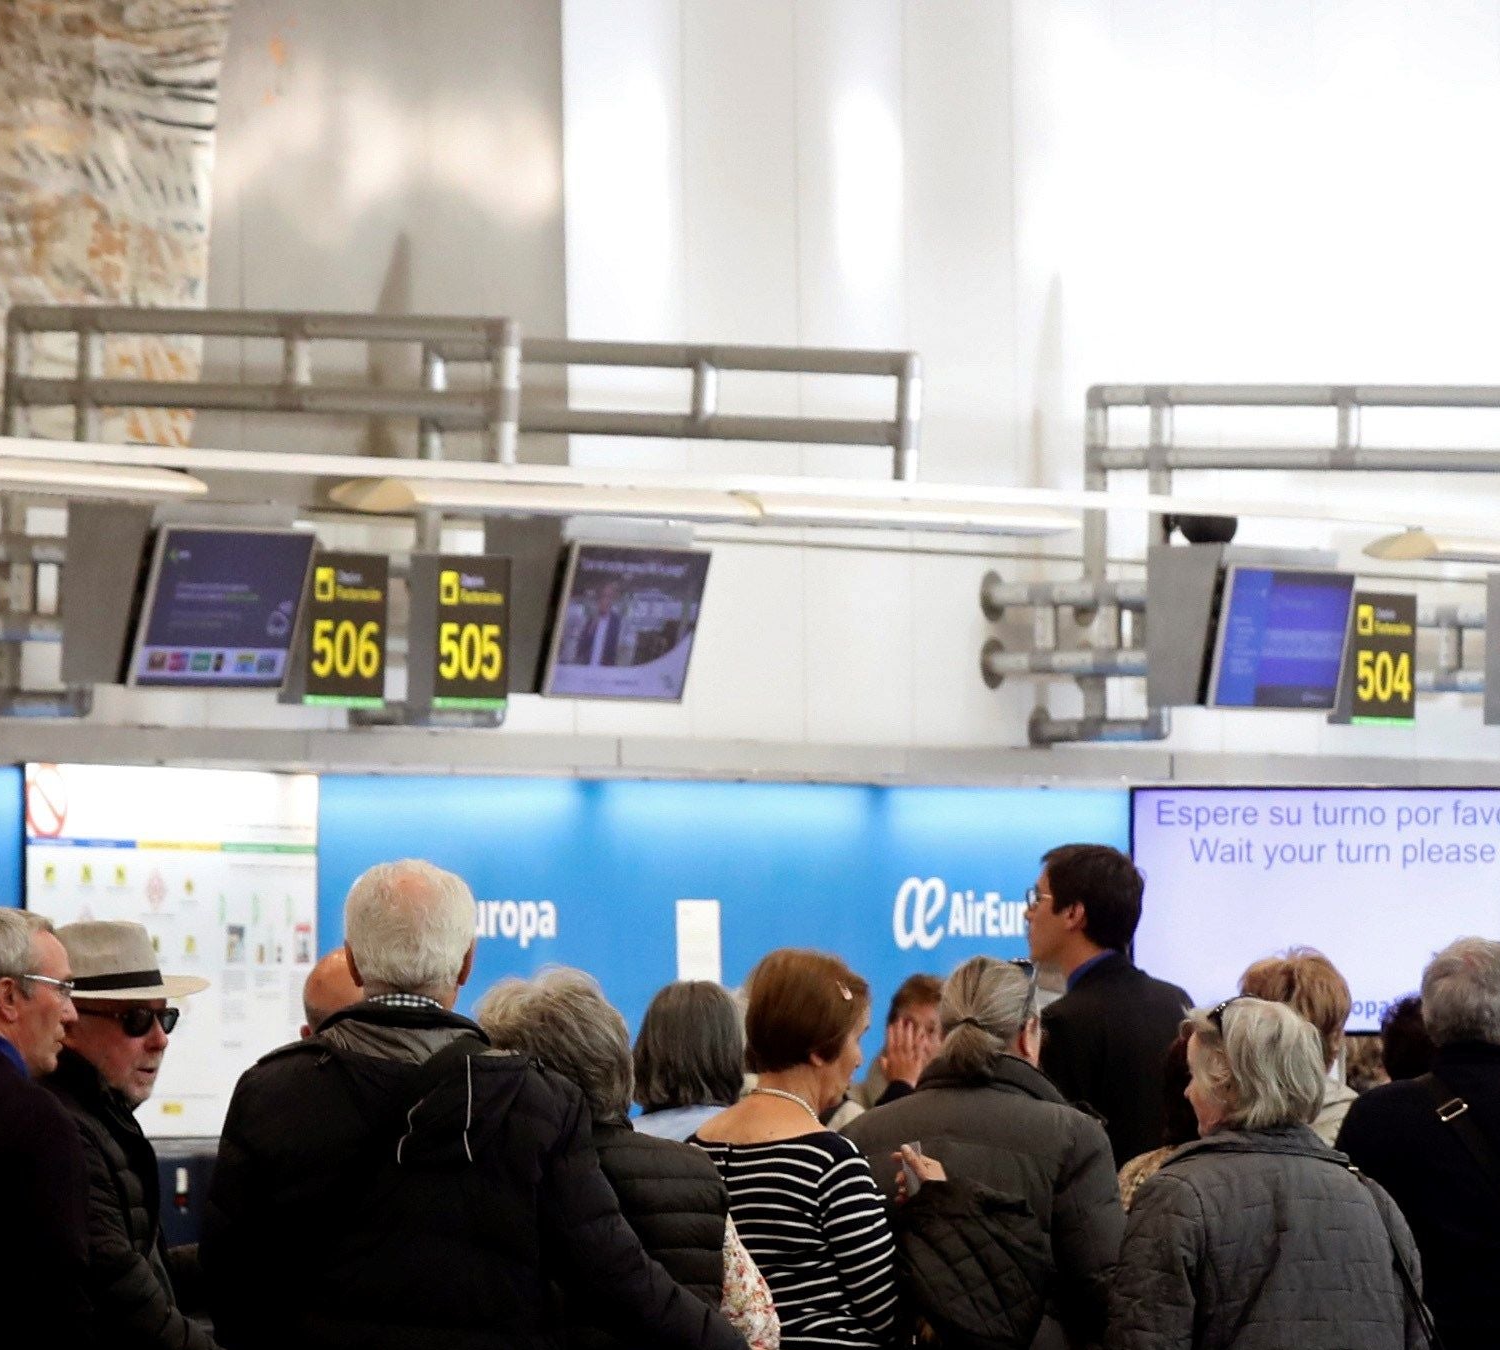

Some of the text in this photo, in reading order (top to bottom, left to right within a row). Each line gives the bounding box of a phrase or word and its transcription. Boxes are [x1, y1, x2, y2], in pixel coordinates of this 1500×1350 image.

[311, 619, 380, 678] 506
[439, 622, 502, 682] 505
[1357, 650, 1411, 702] 504
[1157, 800, 1258, 831] Espere
[1269, 805, 1301, 826] su
[1313, 802, 1386, 826] turno
[1397, 805, 1442, 831] por
[1190, 837, 1496, 870] Wait your turn please
